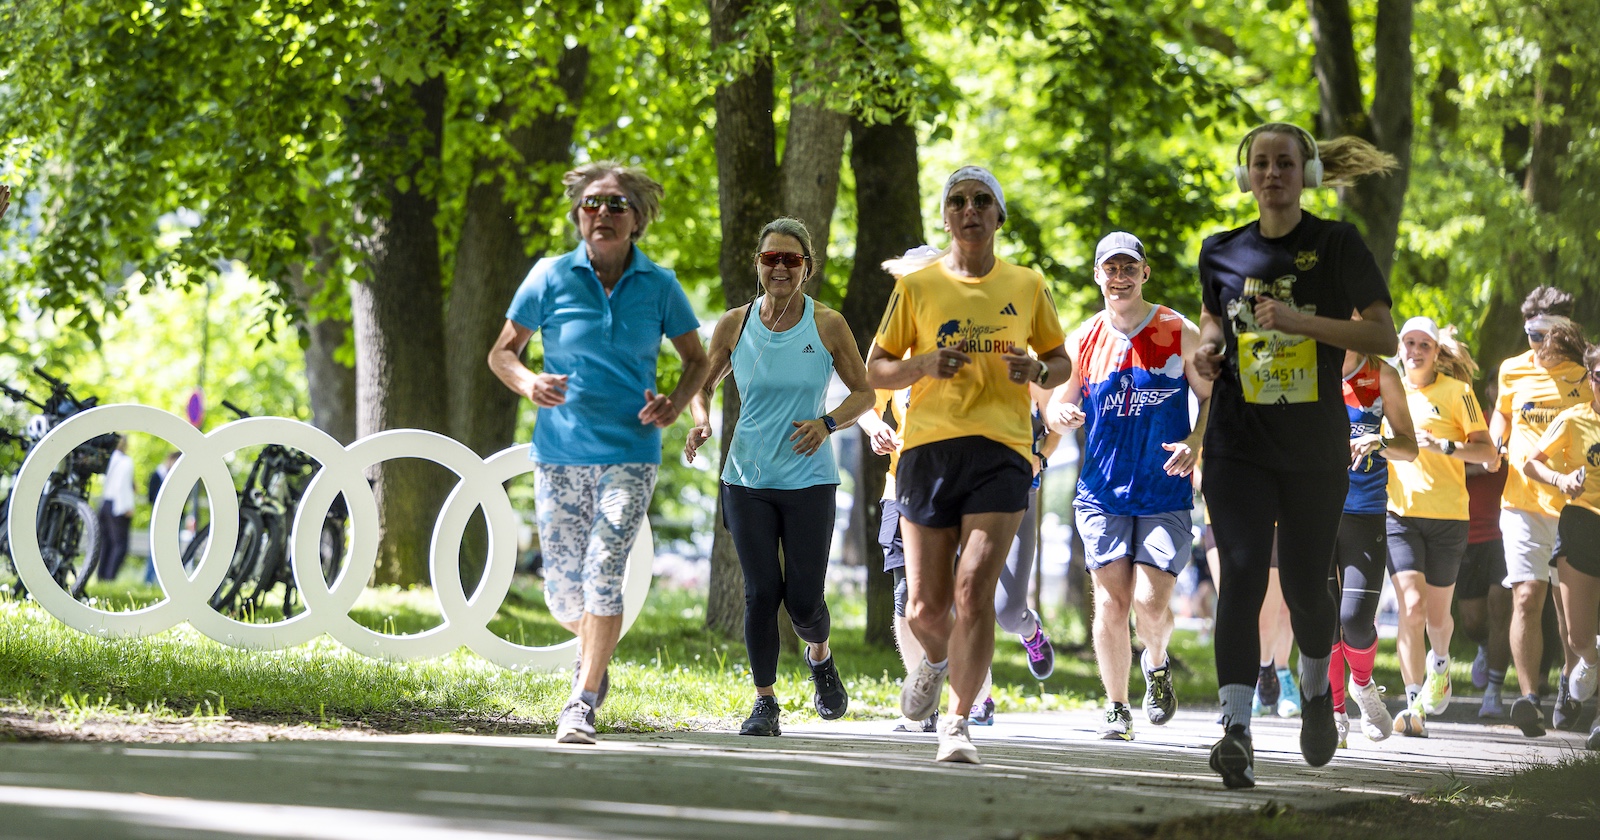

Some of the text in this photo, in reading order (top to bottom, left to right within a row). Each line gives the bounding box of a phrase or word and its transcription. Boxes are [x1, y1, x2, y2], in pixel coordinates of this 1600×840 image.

[1255, 368, 1304, 382] 134511
[1109, 391, 1159, 405] WINGS
[1117, 404, 1142, 416] LIFE
